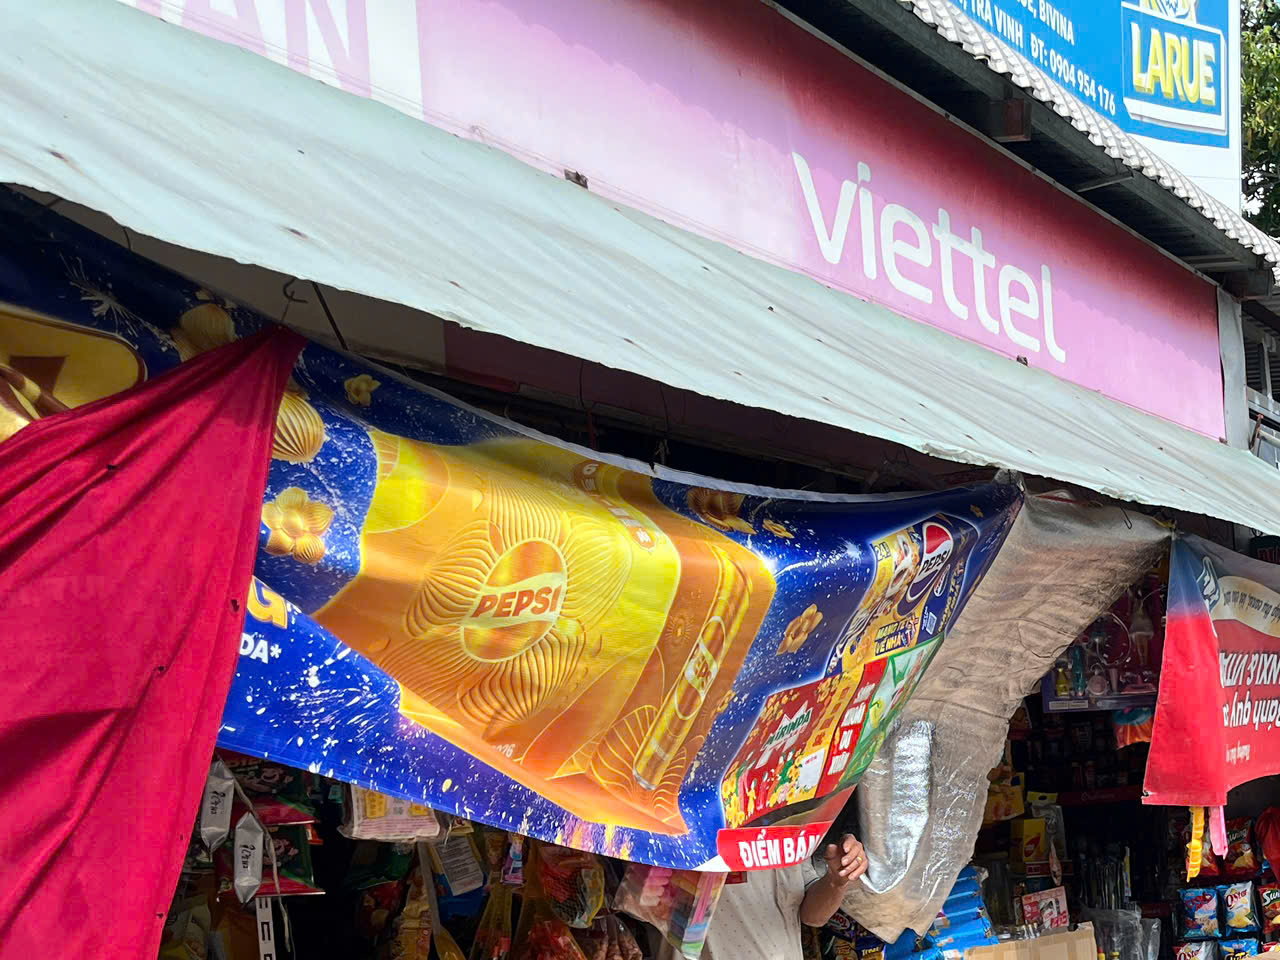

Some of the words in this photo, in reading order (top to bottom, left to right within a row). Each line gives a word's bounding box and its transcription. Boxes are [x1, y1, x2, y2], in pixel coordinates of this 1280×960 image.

[1039, 0, 1075, 46] BIVINA
[994, 4, 1023, 48] VINH
[1031, 32, 1048, 67] ĐT:
[1049, 48, 1076, 88] 0904
[1077, 69, 1096, 102] 954
[1097, 84, 1116, 116] 176
[1130, 21, 1216, 106] LARUE
[792, 151, 1066, 363] viettel
[471, 585, 562, 618] PEPSI
[1230, 691, 1251, 727] quy
[738, 829, 780, 867] ĐIỂM
